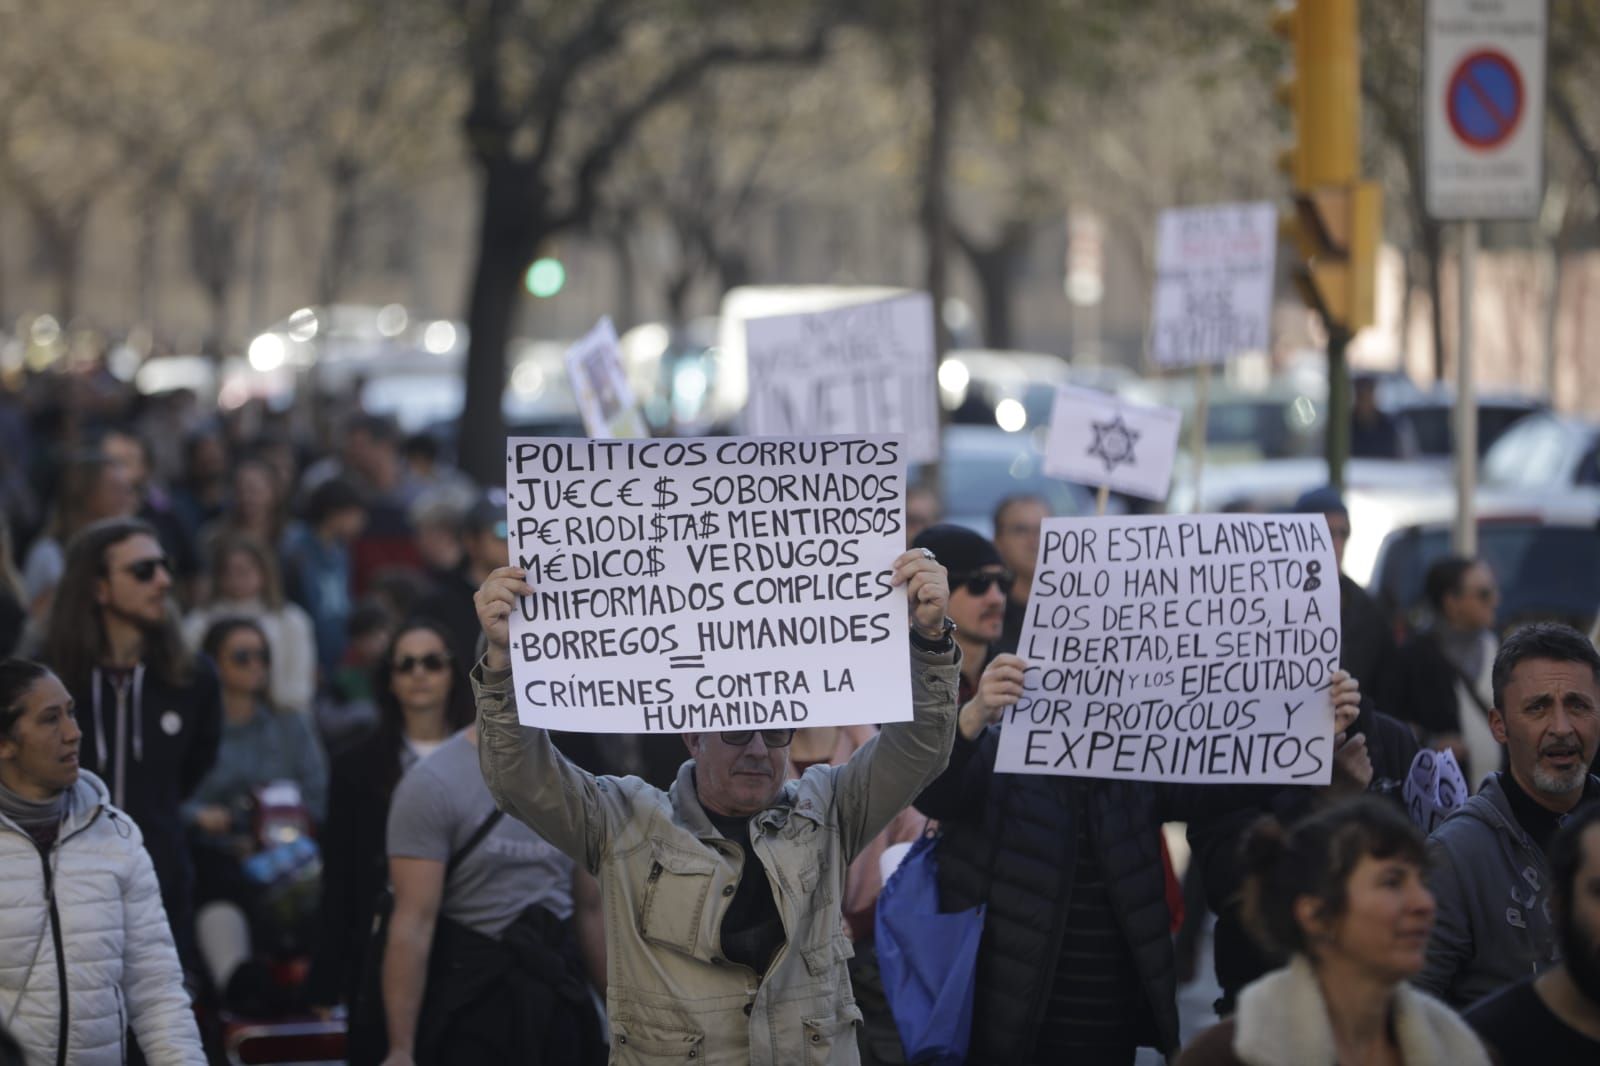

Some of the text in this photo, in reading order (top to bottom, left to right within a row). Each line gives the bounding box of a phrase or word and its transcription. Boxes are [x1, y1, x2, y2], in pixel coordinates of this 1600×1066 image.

[517, 440, 898, 473] POLÍTICOS CORRUPTOS
[690, 473, 899, 506] SOBORNADOS
[729, 508, 901, 538] MENTIROSOS
[687, 540, 859, 573] VERDUGOS
[1042, 522, 1327, 564] POR ESTA PLANDEMIA
[519, 571, 893, 622] UNIFORMADOS COMPLICES
[1035, 570, 1109, 598] SOLO
[1125, 568, 1177, 598] HAN
[1033, 605, 1090, 630] LOS
[1286, 597, 1321, 625] LA
[521, 614, 890, 662] BORREGOS HUMANOIDES
[1216, 627, 1337, 658] SENTIDO
[525, 668, 854, 708] CRÍMENES CONTRA LA
[1022, 665, 1124, 697] COMÚN
[1145, 671, 1174, 687] LOS
[1181, 657, 1337, 703] EJECUTADOS
[644, 700, 808, 731] HUMANIDAD
[1010, 698, 1302, 731] POR PROTOCOLOS Y
[1024, 731, 1324, 779] EXPERIMENTOS
